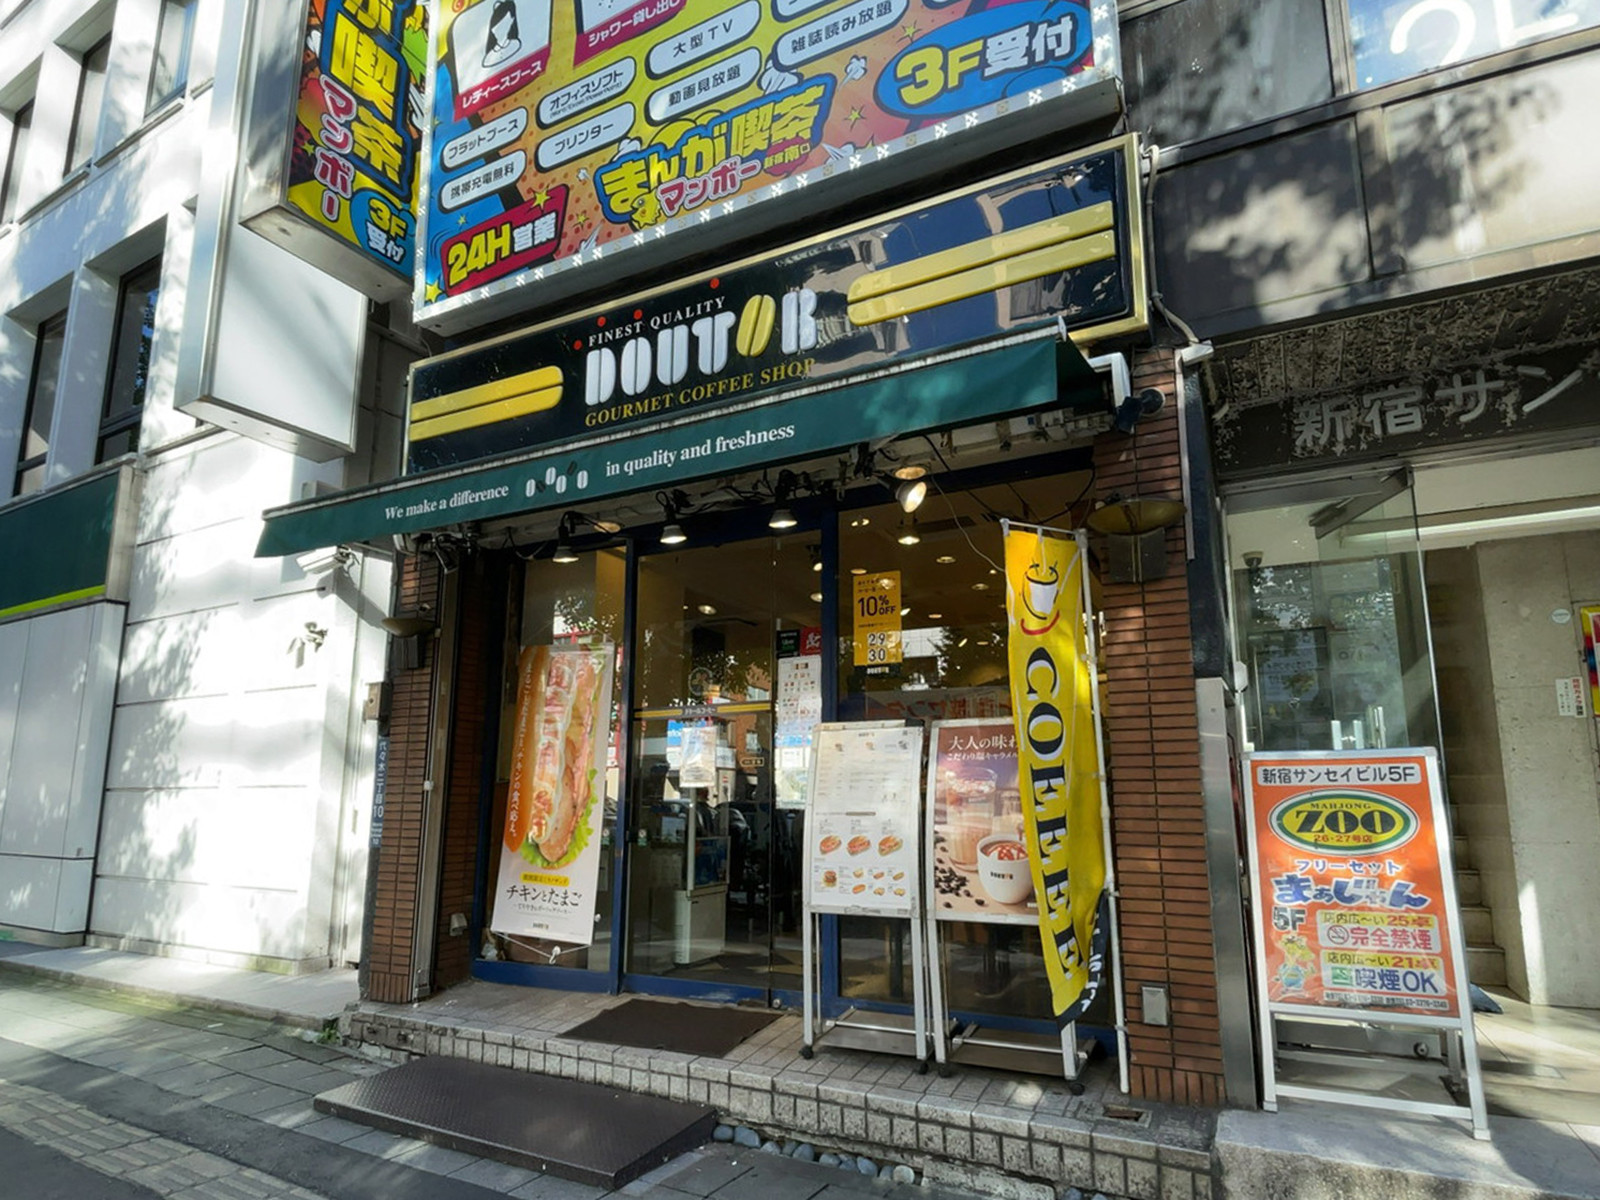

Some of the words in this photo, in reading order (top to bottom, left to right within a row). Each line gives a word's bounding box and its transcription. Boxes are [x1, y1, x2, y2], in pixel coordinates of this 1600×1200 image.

[673, 19, 732, 57] 大型TV
[791, 0, 892, 53] 雑誌読み放題
[462, 61, 542, 108] レディースブース
[550, 70, 623, 111] オフィスソフト
[669, 63, 741, 106] 動画見放題
[316, 77, 356, 219] マンボー
[449, 119, 518, 159] フラットブース
[554, 123, 614, 155] プリンター
[601, 85, 825, 214] まんが喫茶
[450, 163, 514, 199] 携帯充電無料
[660, 162, 757, 211] マンボー
[370, 200, 406, 236] 3F
[367, 222, 404, 262] 受付
[588, 322, 642, 347] FINEST
[650, 296, 726, 329] QUALITY
[585, 288, 817, 406] DOUTOR
[585, 394, 675, 427] GOURMET
[679, 374, 754, 405] COFFEE
[760, 358, 816, 386] SHOP
[1295, 365, 1600, 448] 新宿サン
[606, 461, 620, 477] in
[624, 449, 677, 477] quality
[680, 443, 712, 461] and
[715, 423, 795, 455] freshness
[385, 506, 404, 521] We
[405, 503, 437, 519] make
[439, 501, 447, 511] a
[449, 484, 509, 509] difference
[878, 606, 896, 616] OFF
[868, 633, 886, 646] 29
[868, 648, 886, 662] 30
[1262, 766, 1415, 784] 新宿サンセイビル5F
[373, 805, 384, 818] 10
[1296, 810, 1396, 834] ZOO
[1296, 860, 1401, 874] フリーセット
[506, 884, 582, 907] チキンとたまご
[1273, 906, 1306, 931] 5F
[1350, 927, 1433, 950] 完全禁煙
[1355, 968, 1438, 993] 喫煙OK
